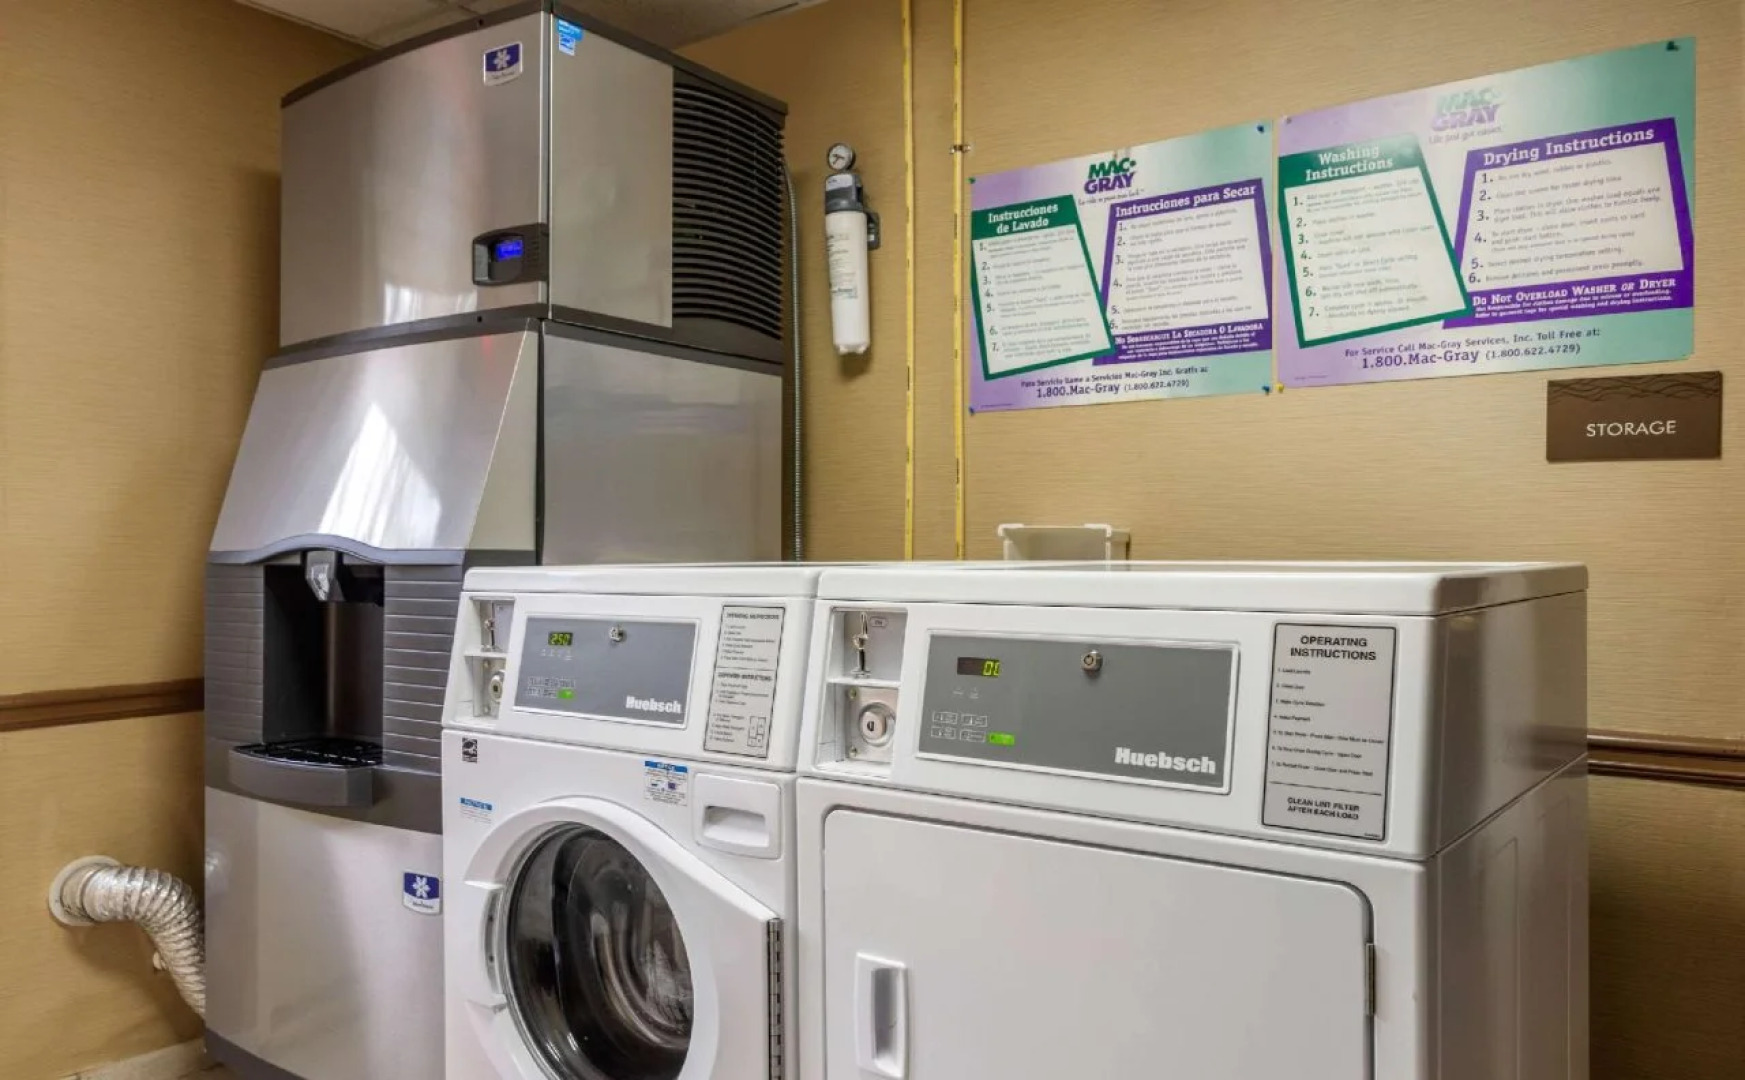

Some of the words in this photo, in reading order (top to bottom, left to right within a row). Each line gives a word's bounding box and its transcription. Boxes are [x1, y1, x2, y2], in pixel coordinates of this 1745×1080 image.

[1431, 104, 1501, 131] GRAY
[1484, 147, 1539, 165] Drying
[1546, 128, 1654, 155] Instructions
[1319, 145, 1379, 165] Washing
[1306, 157, 1393, 181] Instructions
[1084, 171, 1135, 194] GRAY
[1482, 172, 1493, 183] 1.
[1115, 196, 1190, 217] Instrucciones
[1193, 192, 1220, 207] para
[1223, 186, 1256, 200] Secar
[1479, 190, 1492, 201] 2.
[988, 204, 1059, 224] Instrucciones
[1477, 209, 1489, 221] 3.
[996, 222, 1010, 234] de
[1012, 218, 1049, 232] Lavado
[1296, 217, 1307, 228] 2.
[1298, 234, 1309, 244] 3.
[1474, 232, 1486, 244] 4.
[1471, 257, 1484, 269] 5.
[1303, 267, 1314, 277] 5.
[1469, 272, 1481, 283] 6.
[1306, 286, 1317, 297] 6.
[1472, 295, 1487, 306] DO
[1491, 293, 1513, 305] NOT
[1516, 288, 1568, 301] OVERLOAD
[1571, 284, 1617, 296] WASHER
[1639, 278, 1676, 290] DRYER
[1345, 348, 1359, 357] For
[1362, 346, 1394, 355] Service
[1398, 343, 1415, 352] Call
[1419, 340, 1461, 349] Mac-Gray
[1513, 333, 1533, 343] Inc.
[1537, 331, 1555, 340] Toll
[1560, 329, 1582, 339] Free
[1586, 328, 1600, 337] at:
[1362, 350, 1480, 369] 1.800.Mac-Gray
[1485, 343, 1581, 360] (1.800.622.4729)
[1037, 383, 1120, 399] 1.800.Mac-Gray
[1586, 419, 1677, 438] STORAGE
[1300, 634, 1368, 648] OPERATING
[1290, 647, 1377, 661] INSTRUCTIONS
[626, 695, 682, 715] Huebsch
[1114, 746, 1217, 775] Huebsch
[1287, 796, 1314, 807] CLEAN
[1287, 805, 1313, 815] AFTER
[1314, 808, 1336, 818] EACH
